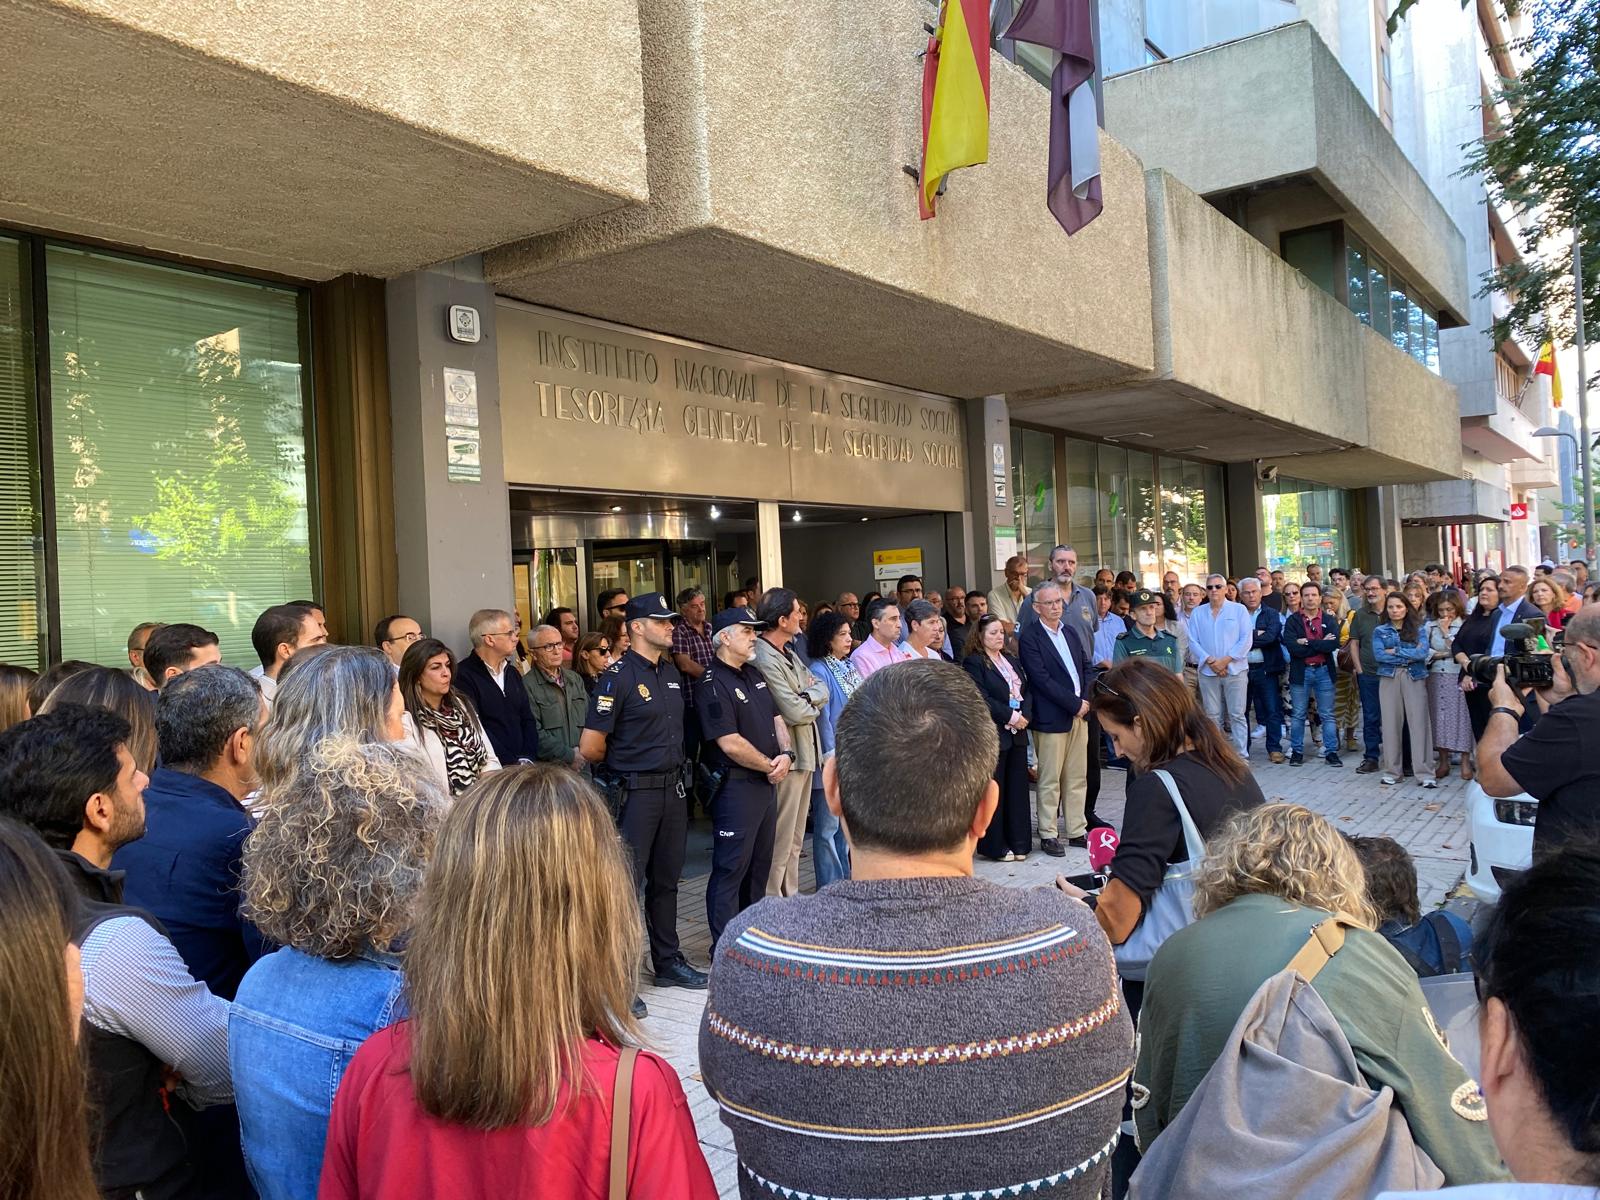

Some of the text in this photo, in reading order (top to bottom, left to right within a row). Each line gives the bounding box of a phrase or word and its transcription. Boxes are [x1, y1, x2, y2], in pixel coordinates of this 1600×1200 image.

[537, 329, 959, 436] INSTITUTO NACIONAL DE LA SEGURIDAD SOCIAL
[682, 403, 768, 447] GENERAL
[778, 418, 802, 451] DE
[811, 423, 833, 455] LA
[842, 429, 915, 463] SEGURIDAD
[922, 440, 963, 470] SOCIAL
[719, 830, 735, 838] CNP
